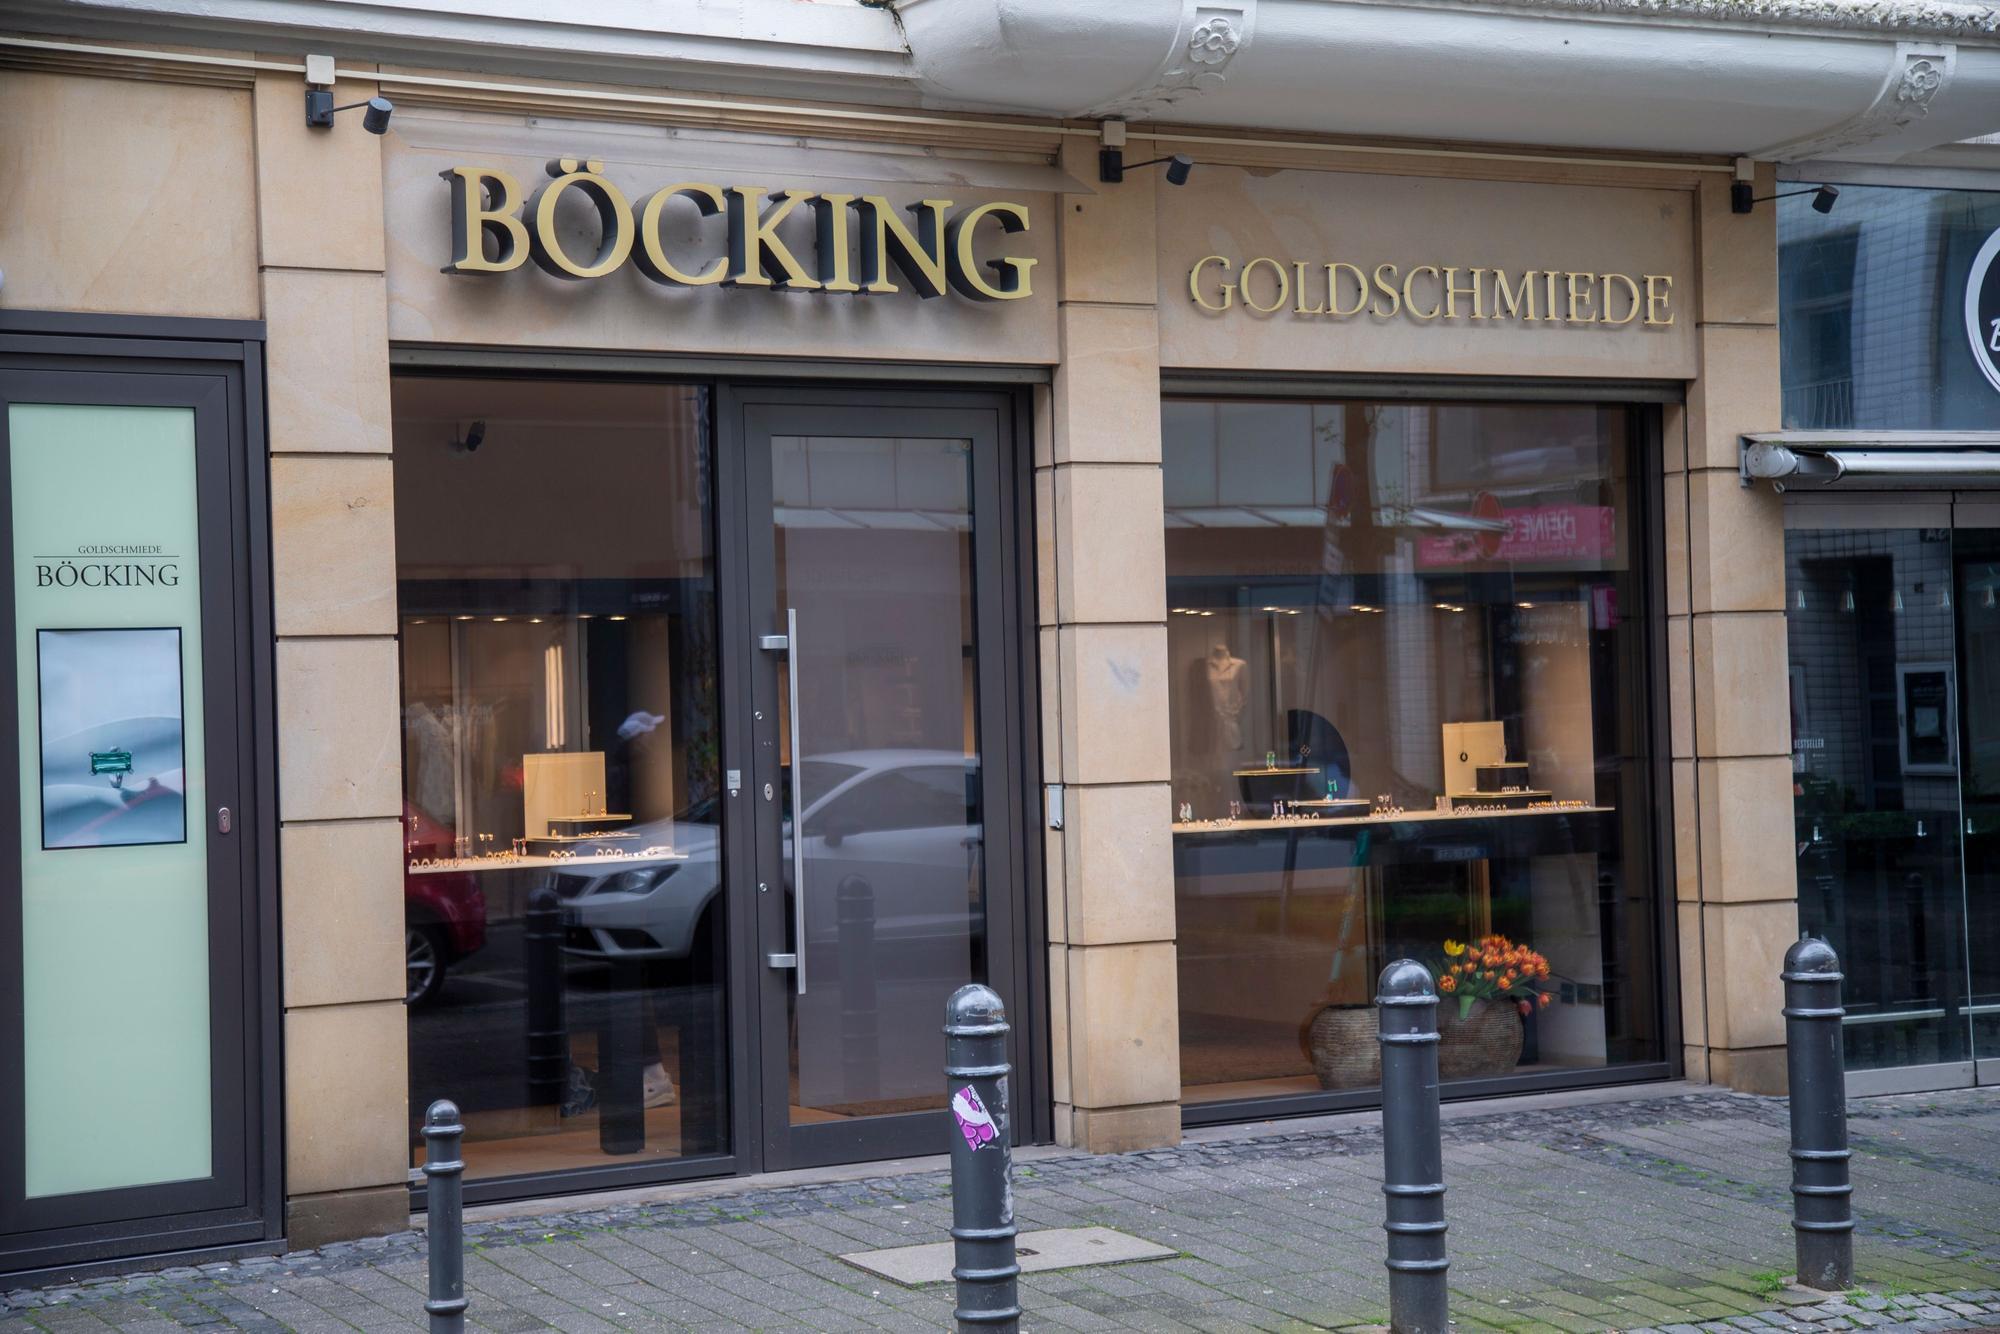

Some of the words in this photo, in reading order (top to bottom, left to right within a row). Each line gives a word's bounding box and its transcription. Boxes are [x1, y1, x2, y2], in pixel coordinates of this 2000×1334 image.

[442, 158, 1038, 300] BÖCKING
[1189, 255, 1675, 325] GOLDSCHMIEDE
[78, 545, 162, 554] GOLDSCHMIEDE
[36, 561, 179, 587] BÖCKING
